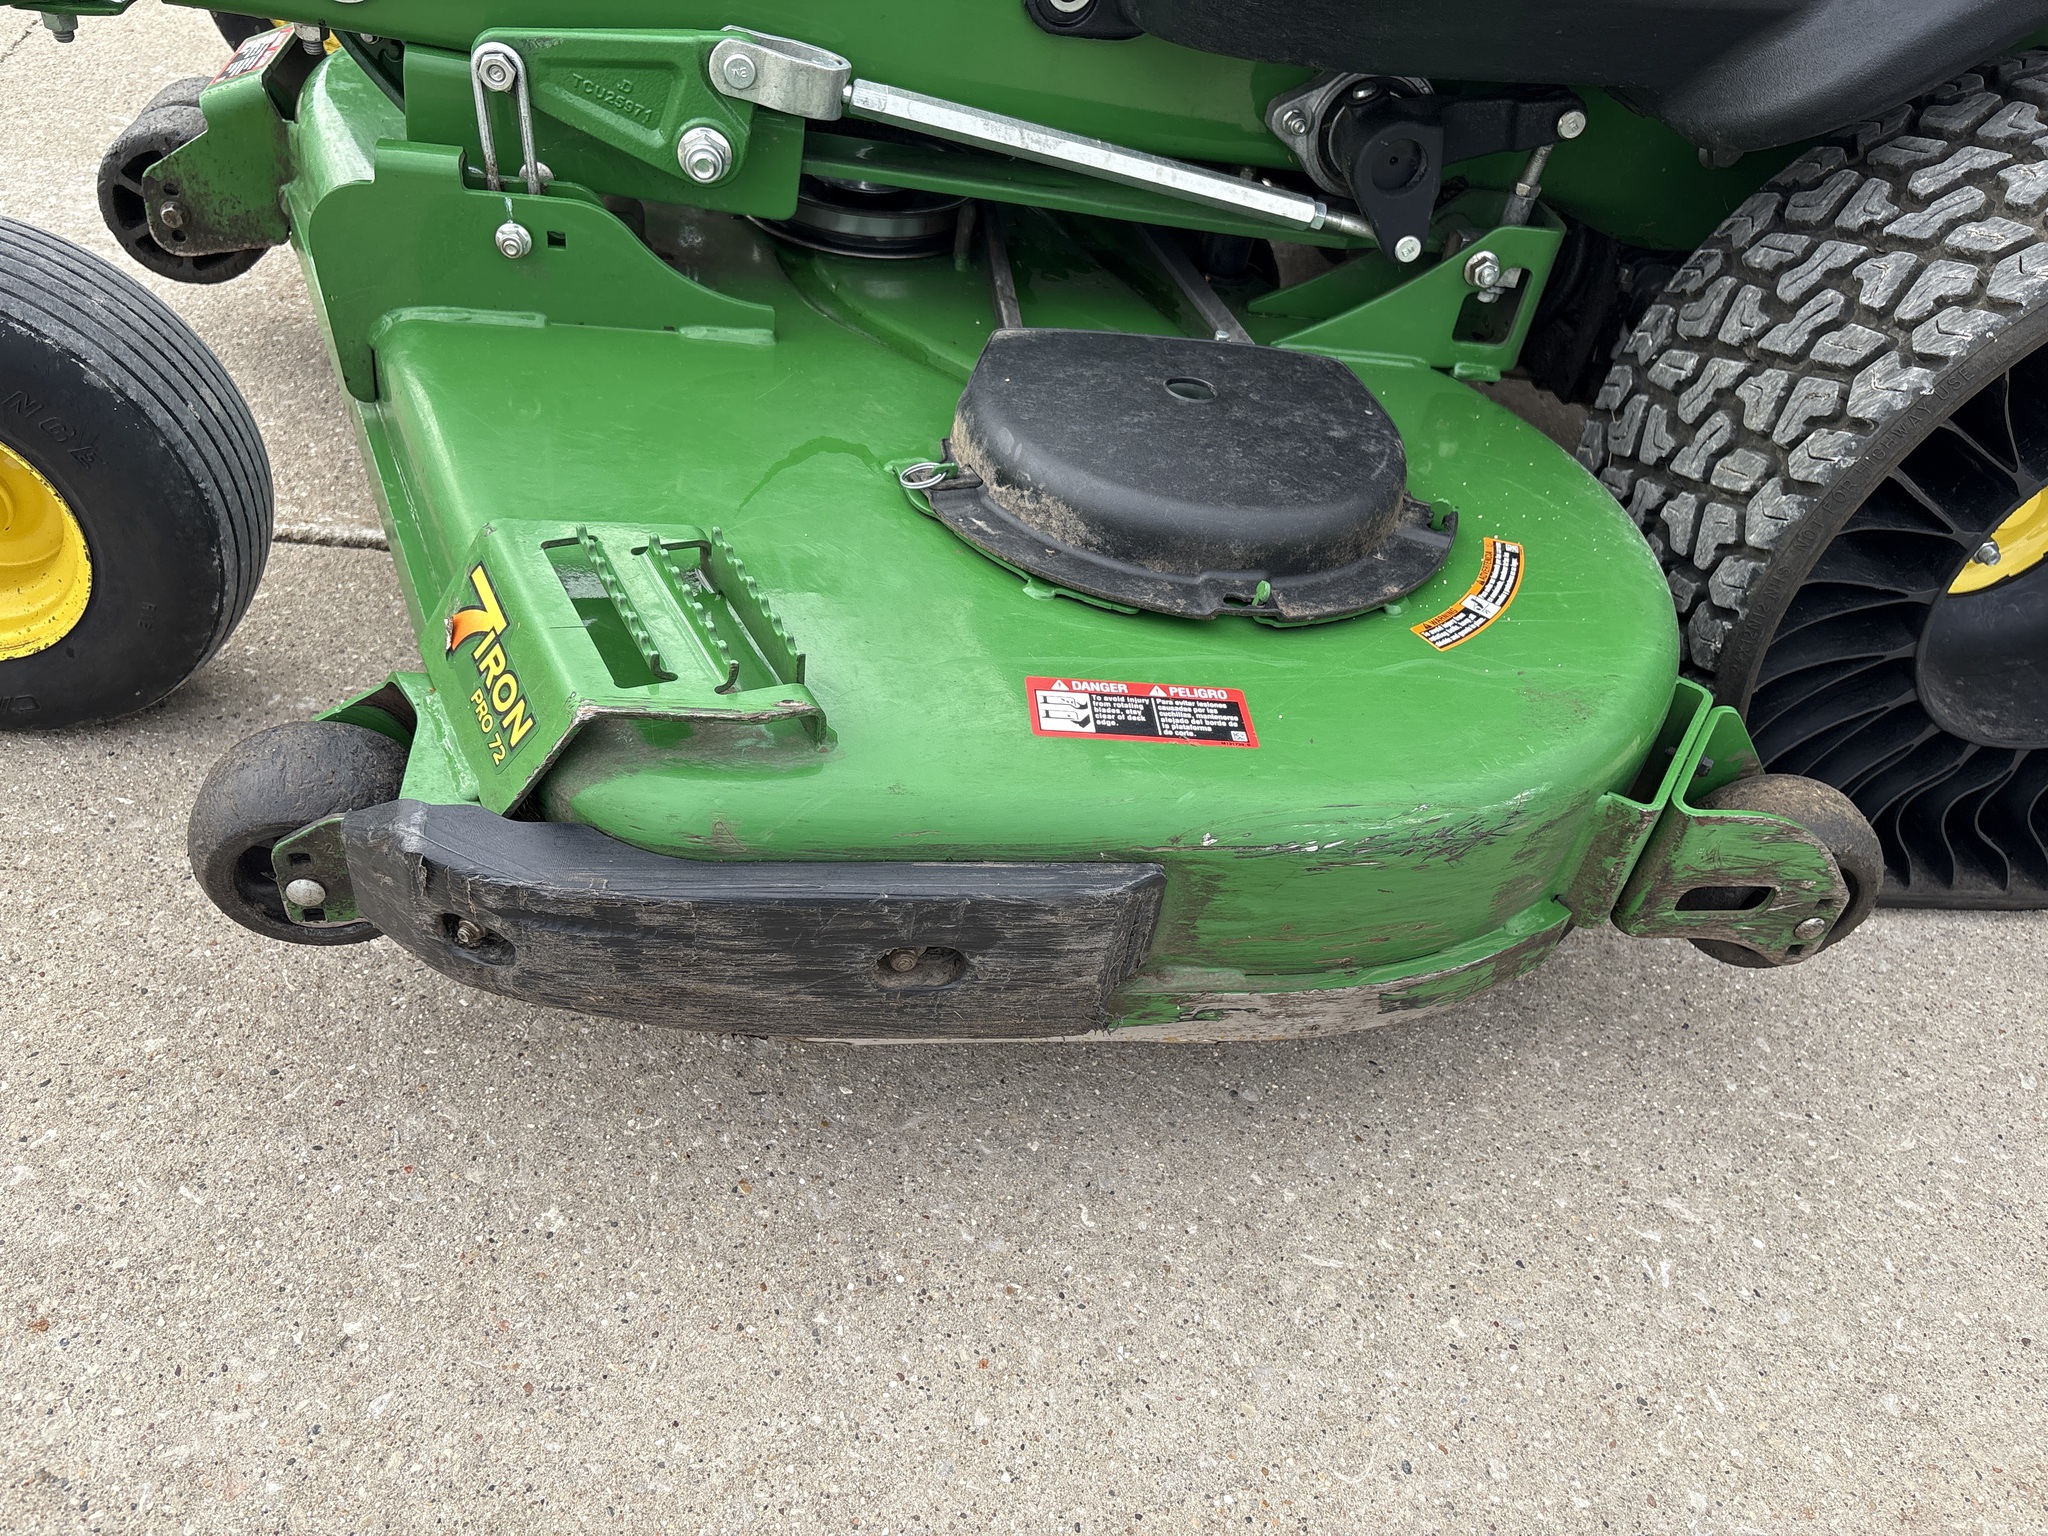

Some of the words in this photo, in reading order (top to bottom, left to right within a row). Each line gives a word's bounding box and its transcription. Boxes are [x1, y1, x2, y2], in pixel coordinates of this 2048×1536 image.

[573, 73, 652, 123] TCU25971
[1763, 566, 1791, 600] NHS
[1793, 519, 1825, 551] NOT
[1822, 471, 1858, 515] FOR
[1855, 400, 1932, 477] HIGHWAY
[1934, 366, 1976, 401] USE
[1430, 607, 1459, 626] WARNING
[1071, 680, 1129, 694] DANGER
[1169, 686, 1228, 700] PELIGRO
[1113, 702, 1144, 710] rotating
[1126, 697, 1149, 705] injury
[1196, 701, 1227, 709] lesiones
[1160, 717, 1189, 725] alejado
[1204, 719, 1227, 727] borde
[1195, 713, 1239, 721] mantenerse
[470, 688, 494, 733] PRO
[487, 732, 506, 766] 72
[1096, 719, 1119, 727] edge.
[1171, 723, 1212, 732] plataforma
